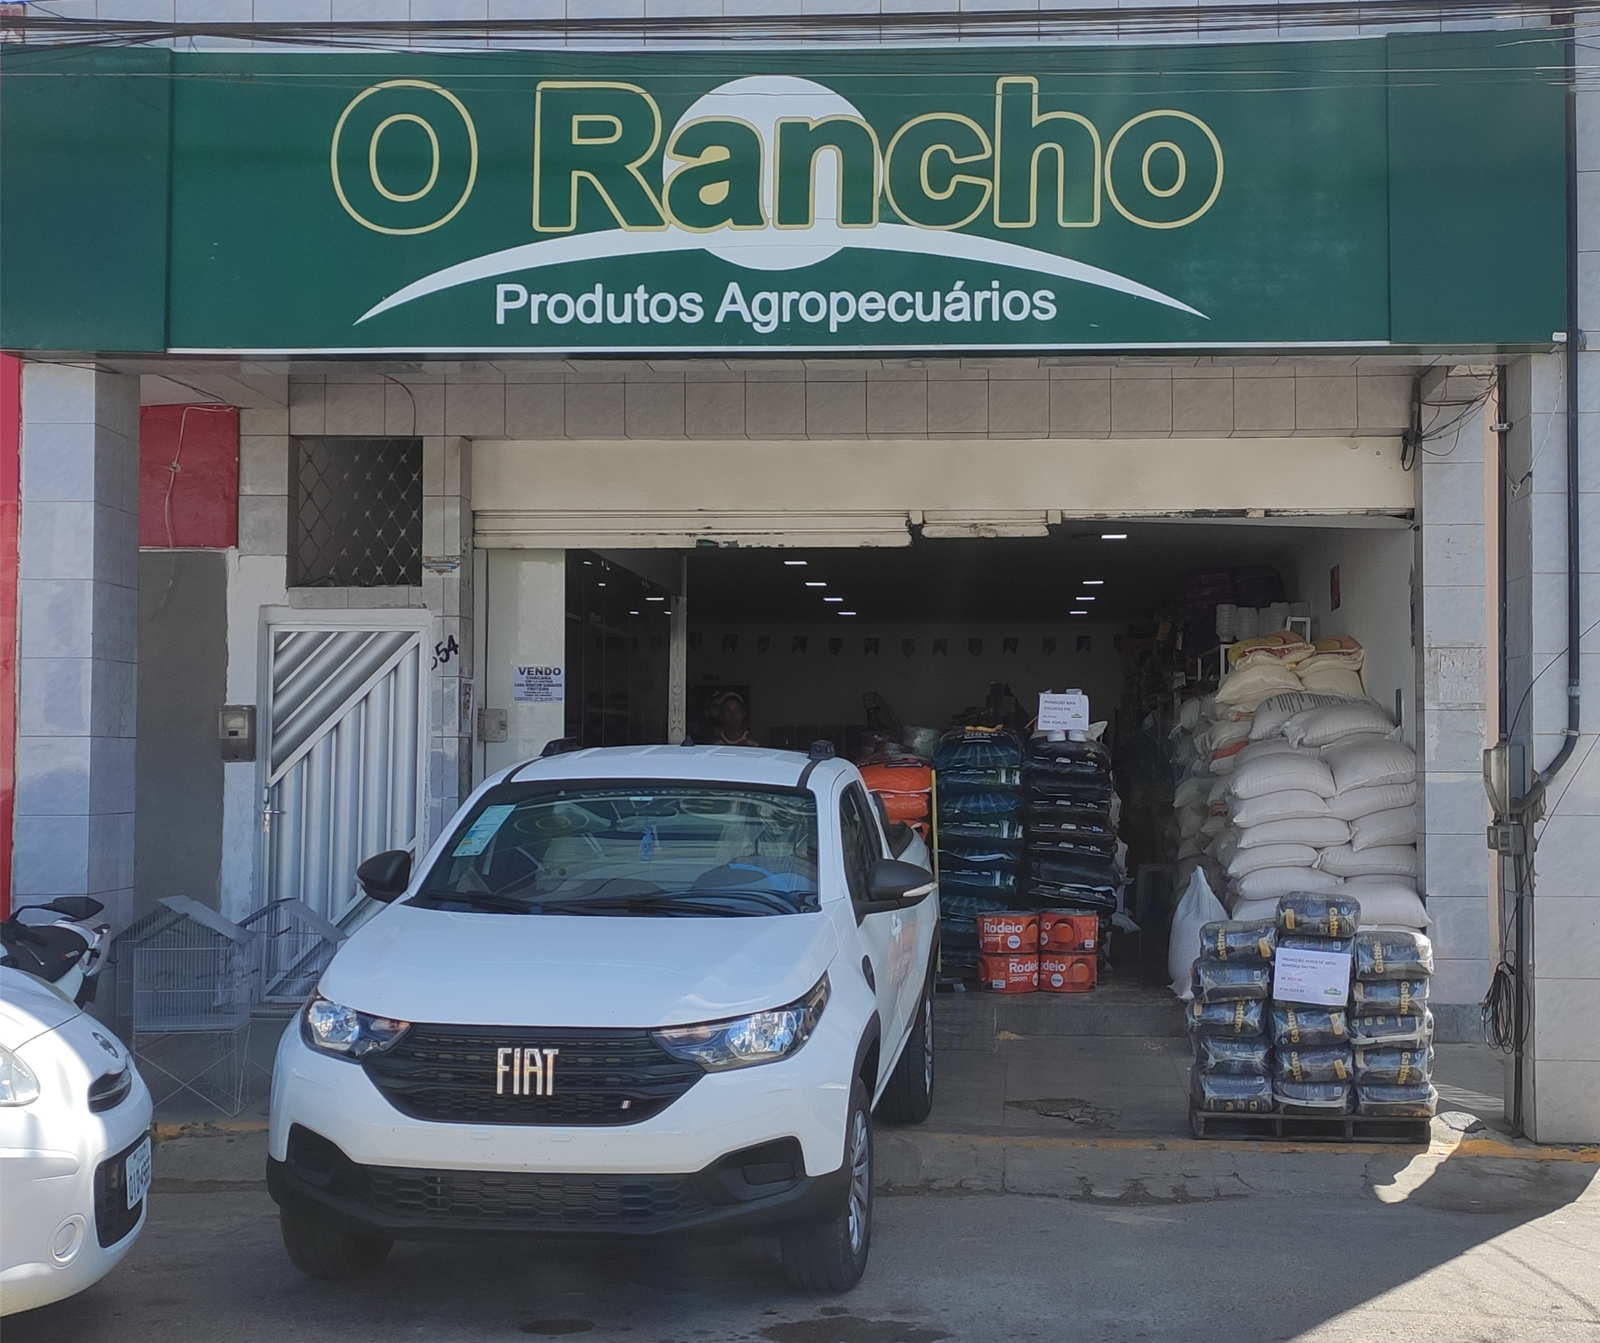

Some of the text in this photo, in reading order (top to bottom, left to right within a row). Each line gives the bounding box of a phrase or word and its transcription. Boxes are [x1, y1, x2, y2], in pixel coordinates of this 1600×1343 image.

[332, 75, 1224, 235] O Rancho
[496, 280, 1057, 333] Produtos Agropecuários
[517, 666, 562, 676] VENDO
[983, 921, 1024, 934] Rodeio
[496, 1047, 560, 1096] FIAT
